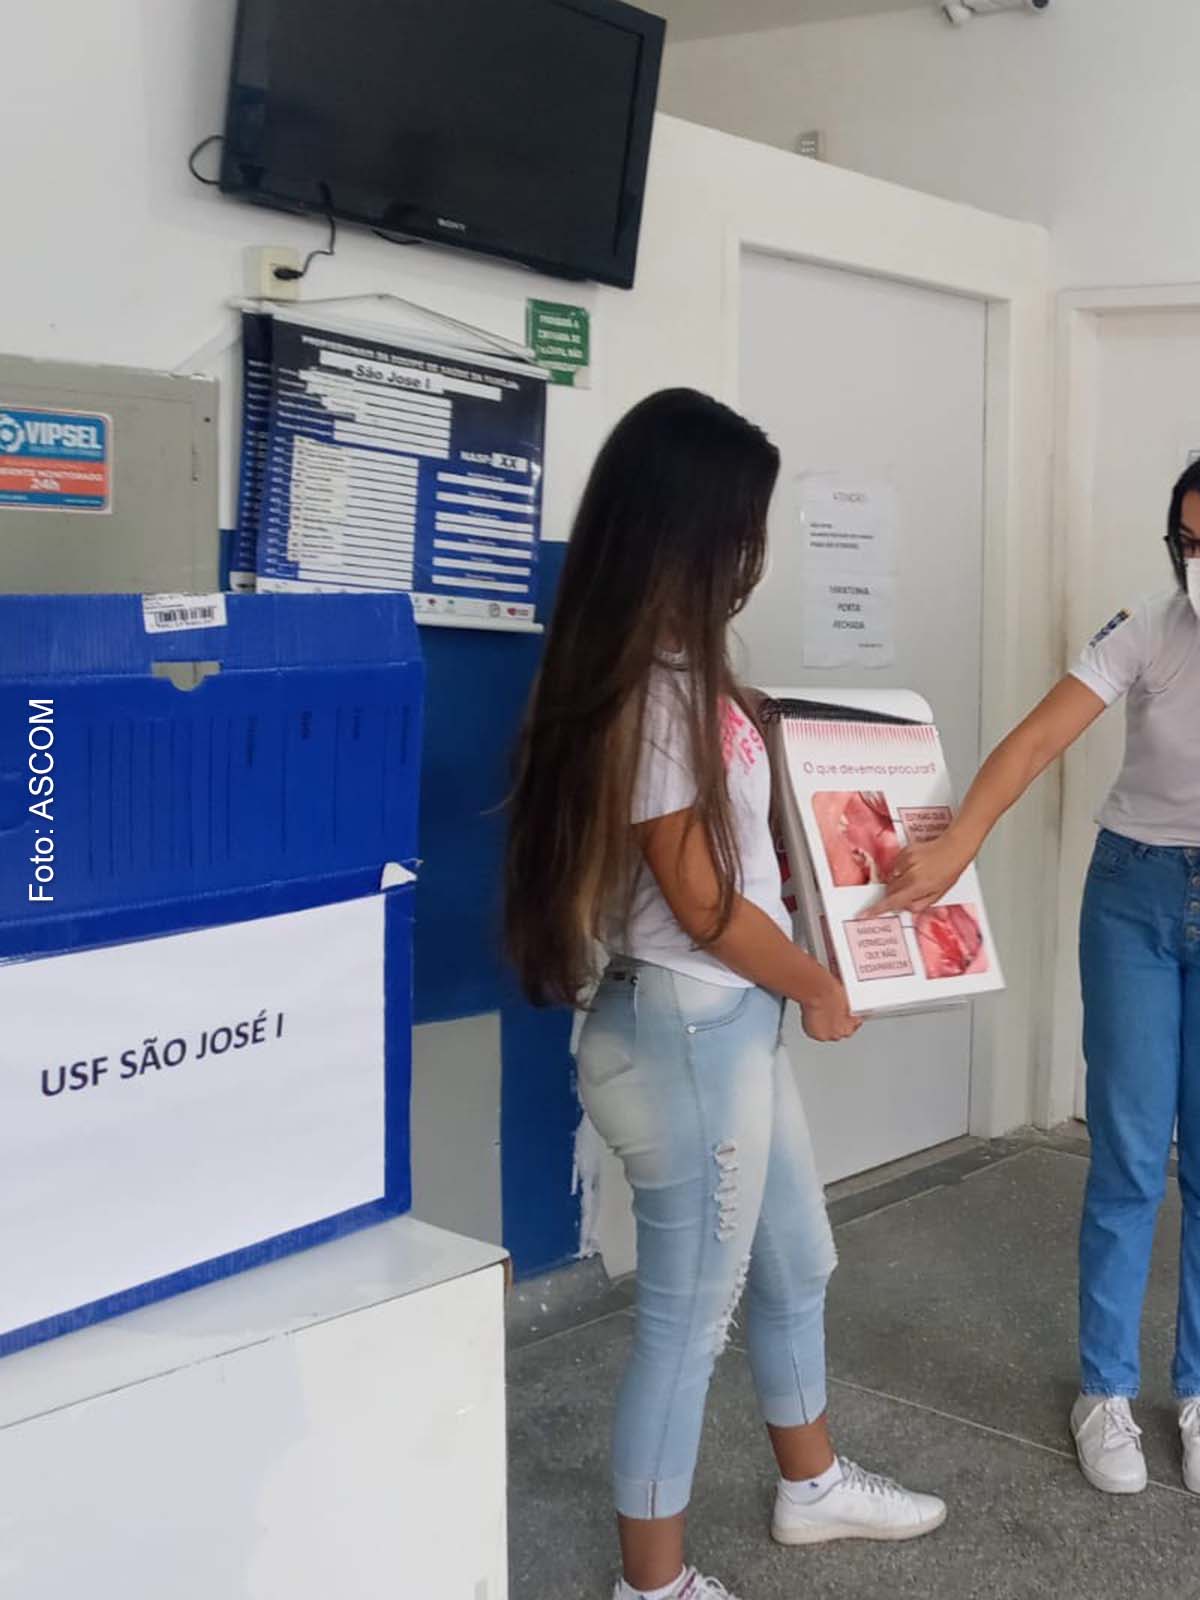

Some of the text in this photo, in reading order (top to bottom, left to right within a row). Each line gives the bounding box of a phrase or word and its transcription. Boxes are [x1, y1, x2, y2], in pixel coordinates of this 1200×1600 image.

[355, 363, 383, 381] São
[24, 420, 102, 449] VIPSEL
[802, 760, 937, 777] O que devemos procurar?
[41, 1009, 284, 1097] USF SÃO JOSÉ I
